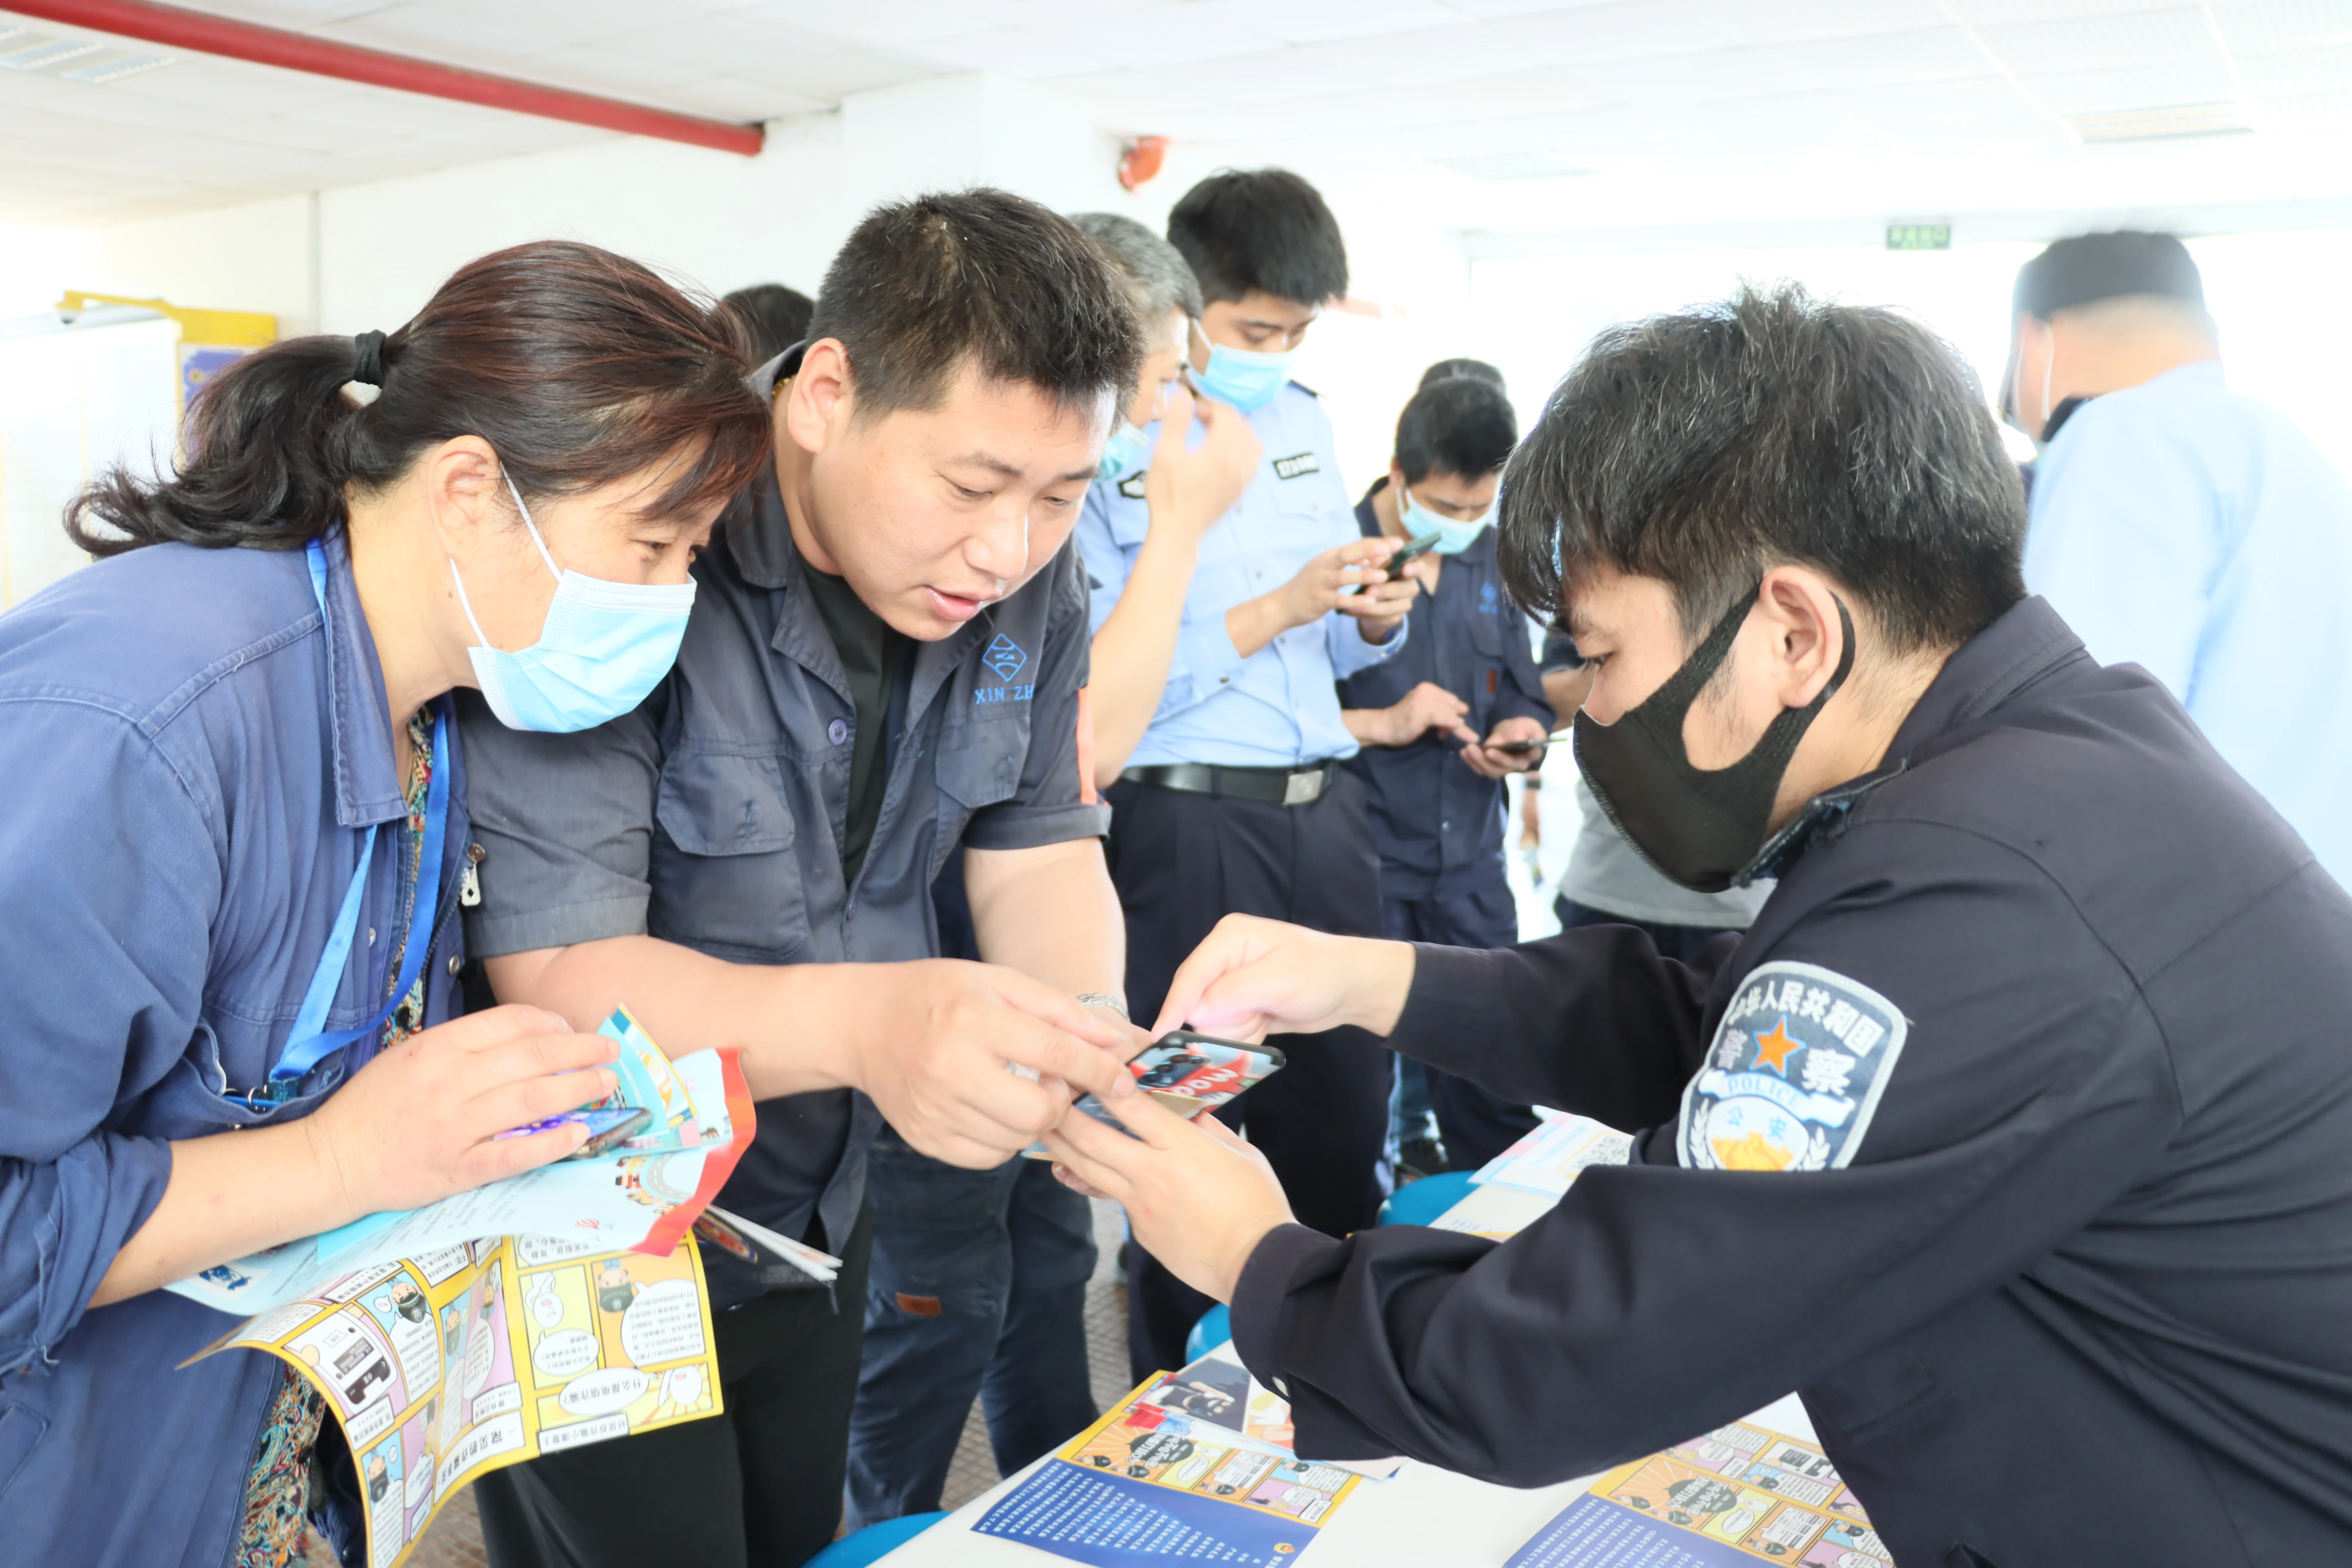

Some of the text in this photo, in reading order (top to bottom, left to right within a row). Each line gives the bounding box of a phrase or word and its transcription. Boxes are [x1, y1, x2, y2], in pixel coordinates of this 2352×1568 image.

[974, 687, 1004, 705] XIN
[1727, 1077, 1801, 1107] POLICE
[563, 1376, 641, 1405] 什么是电信诈骗？
